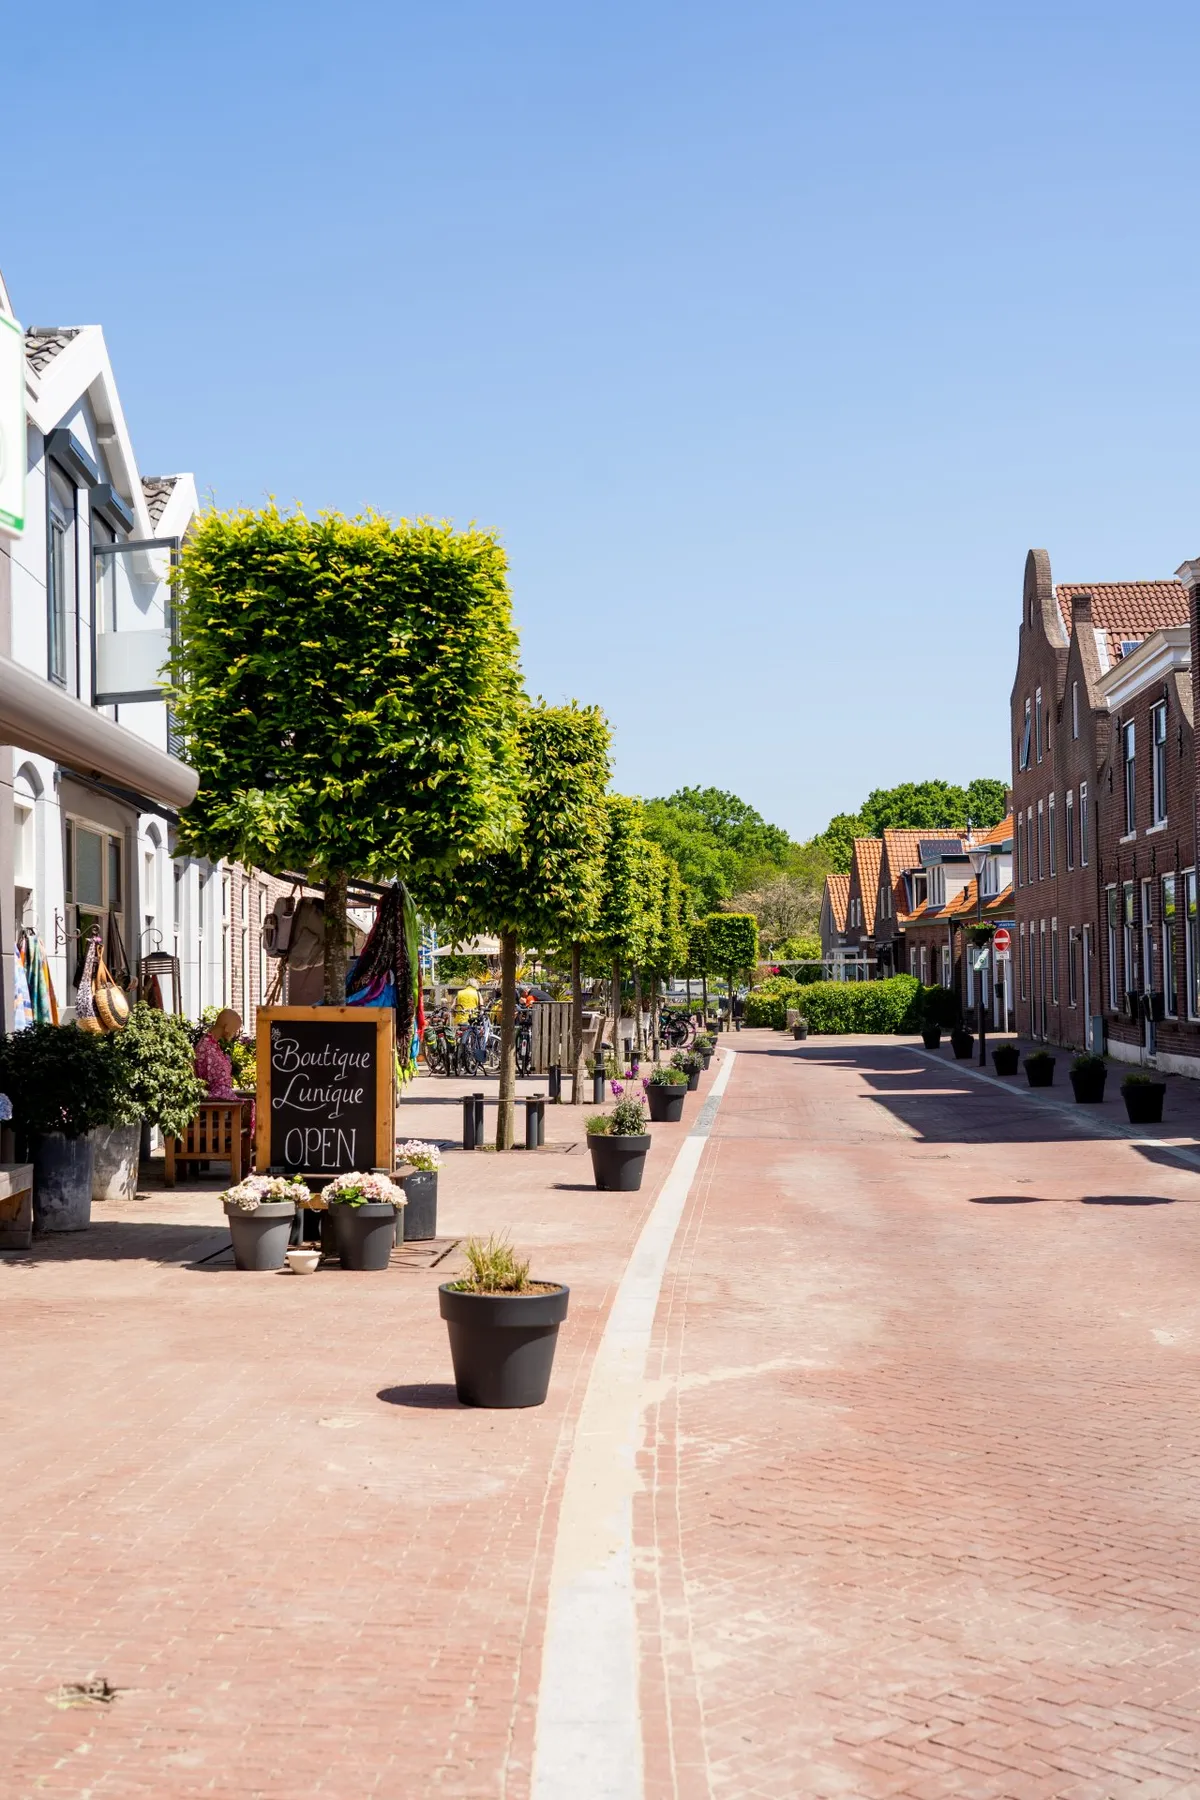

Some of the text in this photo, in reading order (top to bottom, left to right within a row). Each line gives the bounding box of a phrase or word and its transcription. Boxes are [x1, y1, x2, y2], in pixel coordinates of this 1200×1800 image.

[272, 1038, 370, 1081] Boutique
[272, 1073, 364, 1119] Lunique
[284, 1127, 357, 1167] OPEN
